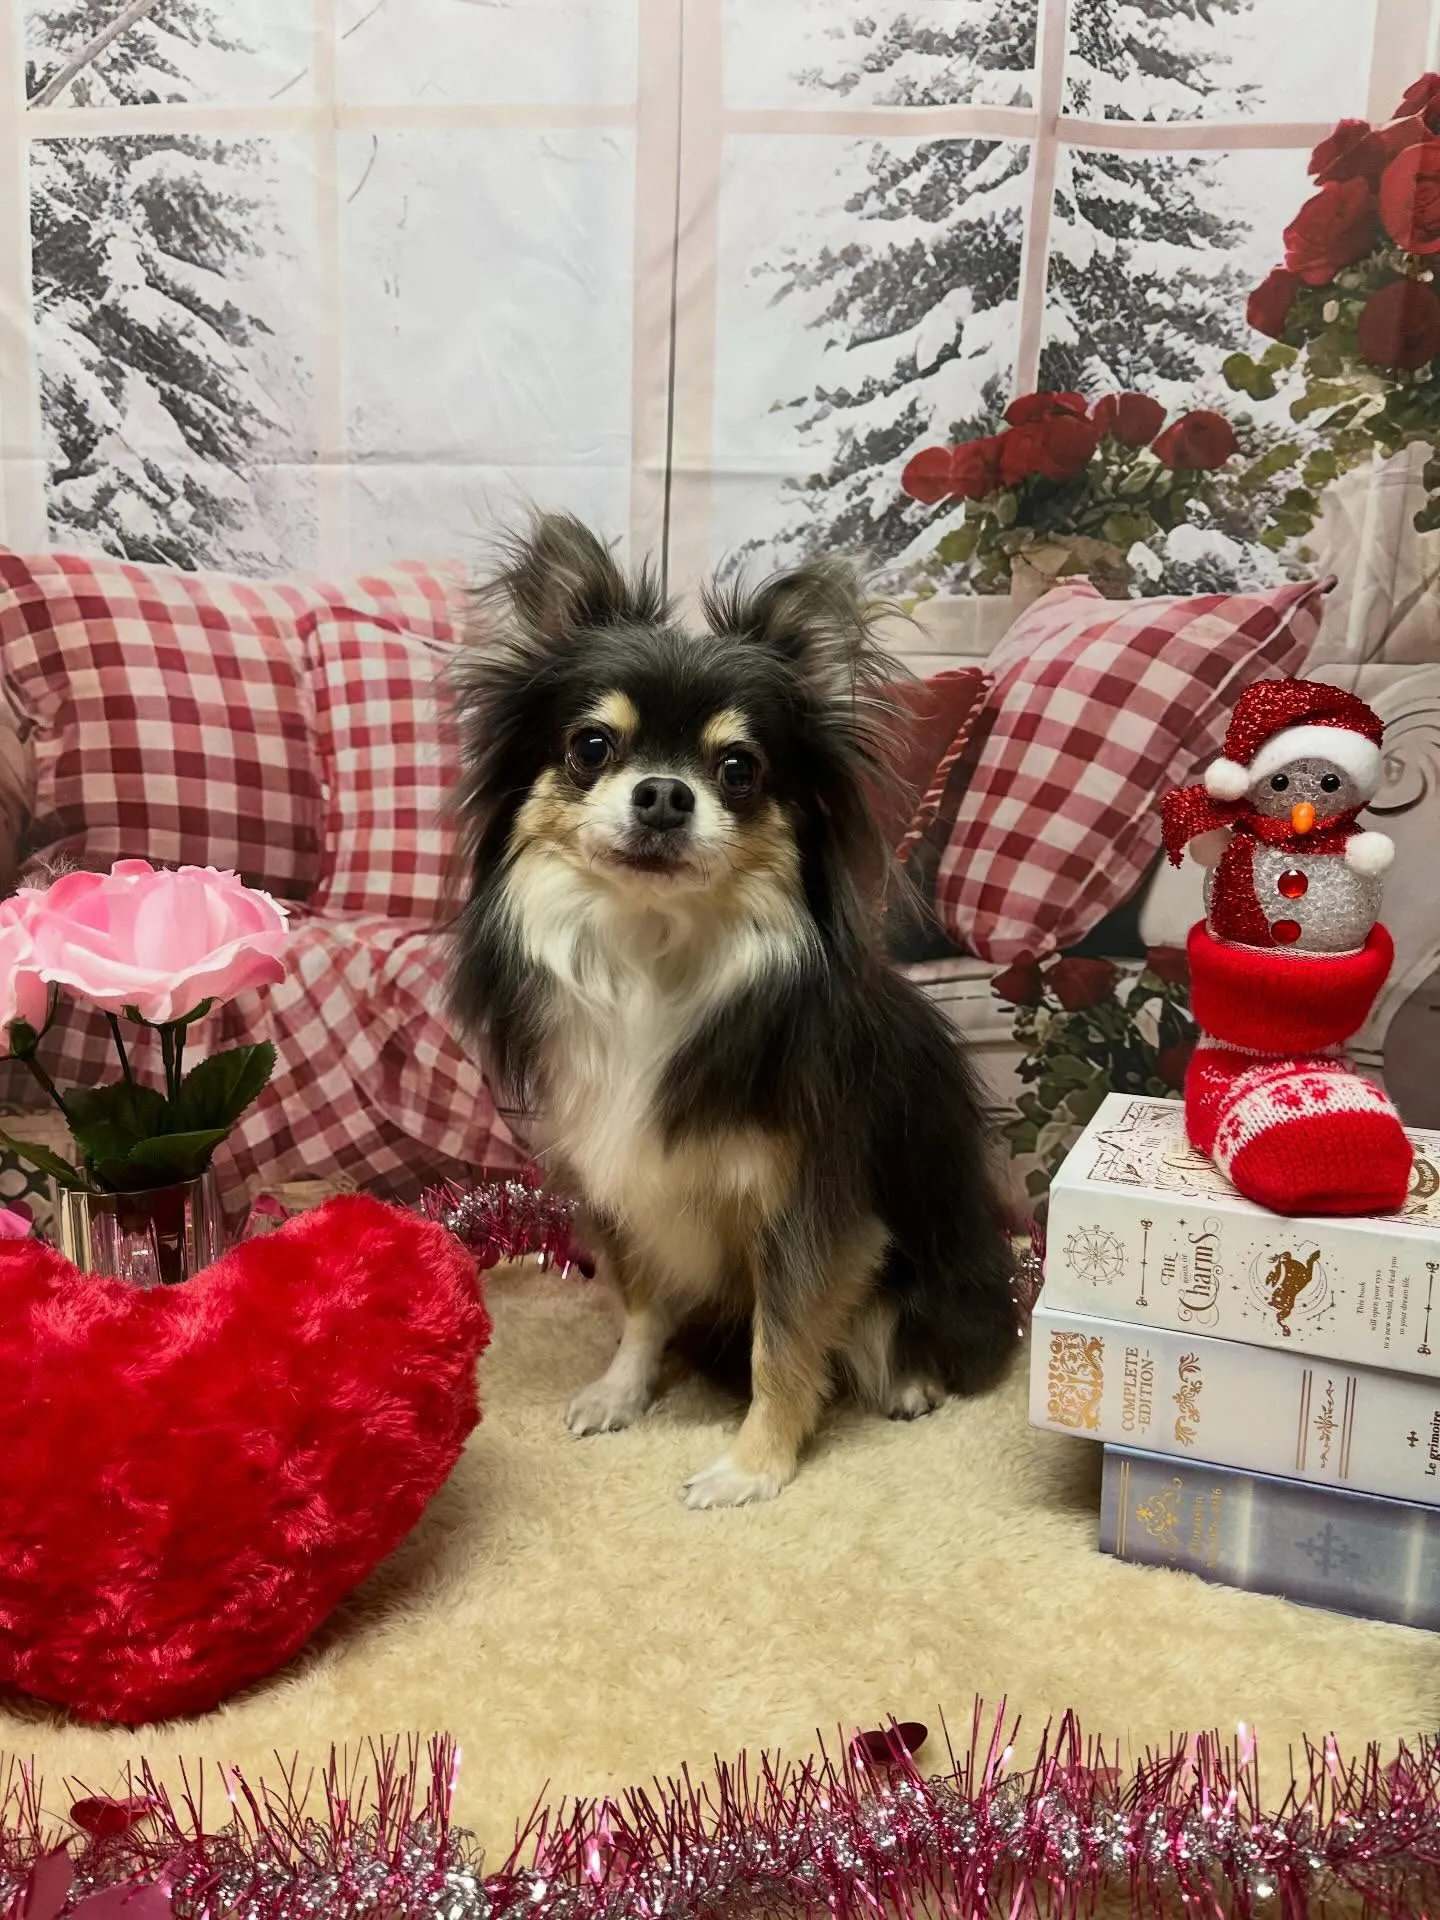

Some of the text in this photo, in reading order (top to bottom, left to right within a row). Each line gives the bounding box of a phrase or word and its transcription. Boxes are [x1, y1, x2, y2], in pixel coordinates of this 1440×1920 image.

[1161, 1252, 1178, 1286] THE
[1356, 1281, 1366, 1314] This book
[1387, 1285, 1395, 1298] and
[1400, 1288, 1409, 1311] dream
[1400, 1312, 1408, 1328] your
[1121, 1347, 1139, 1432] COMPLETE
[1424, 1462, 1437, 1476] Le
